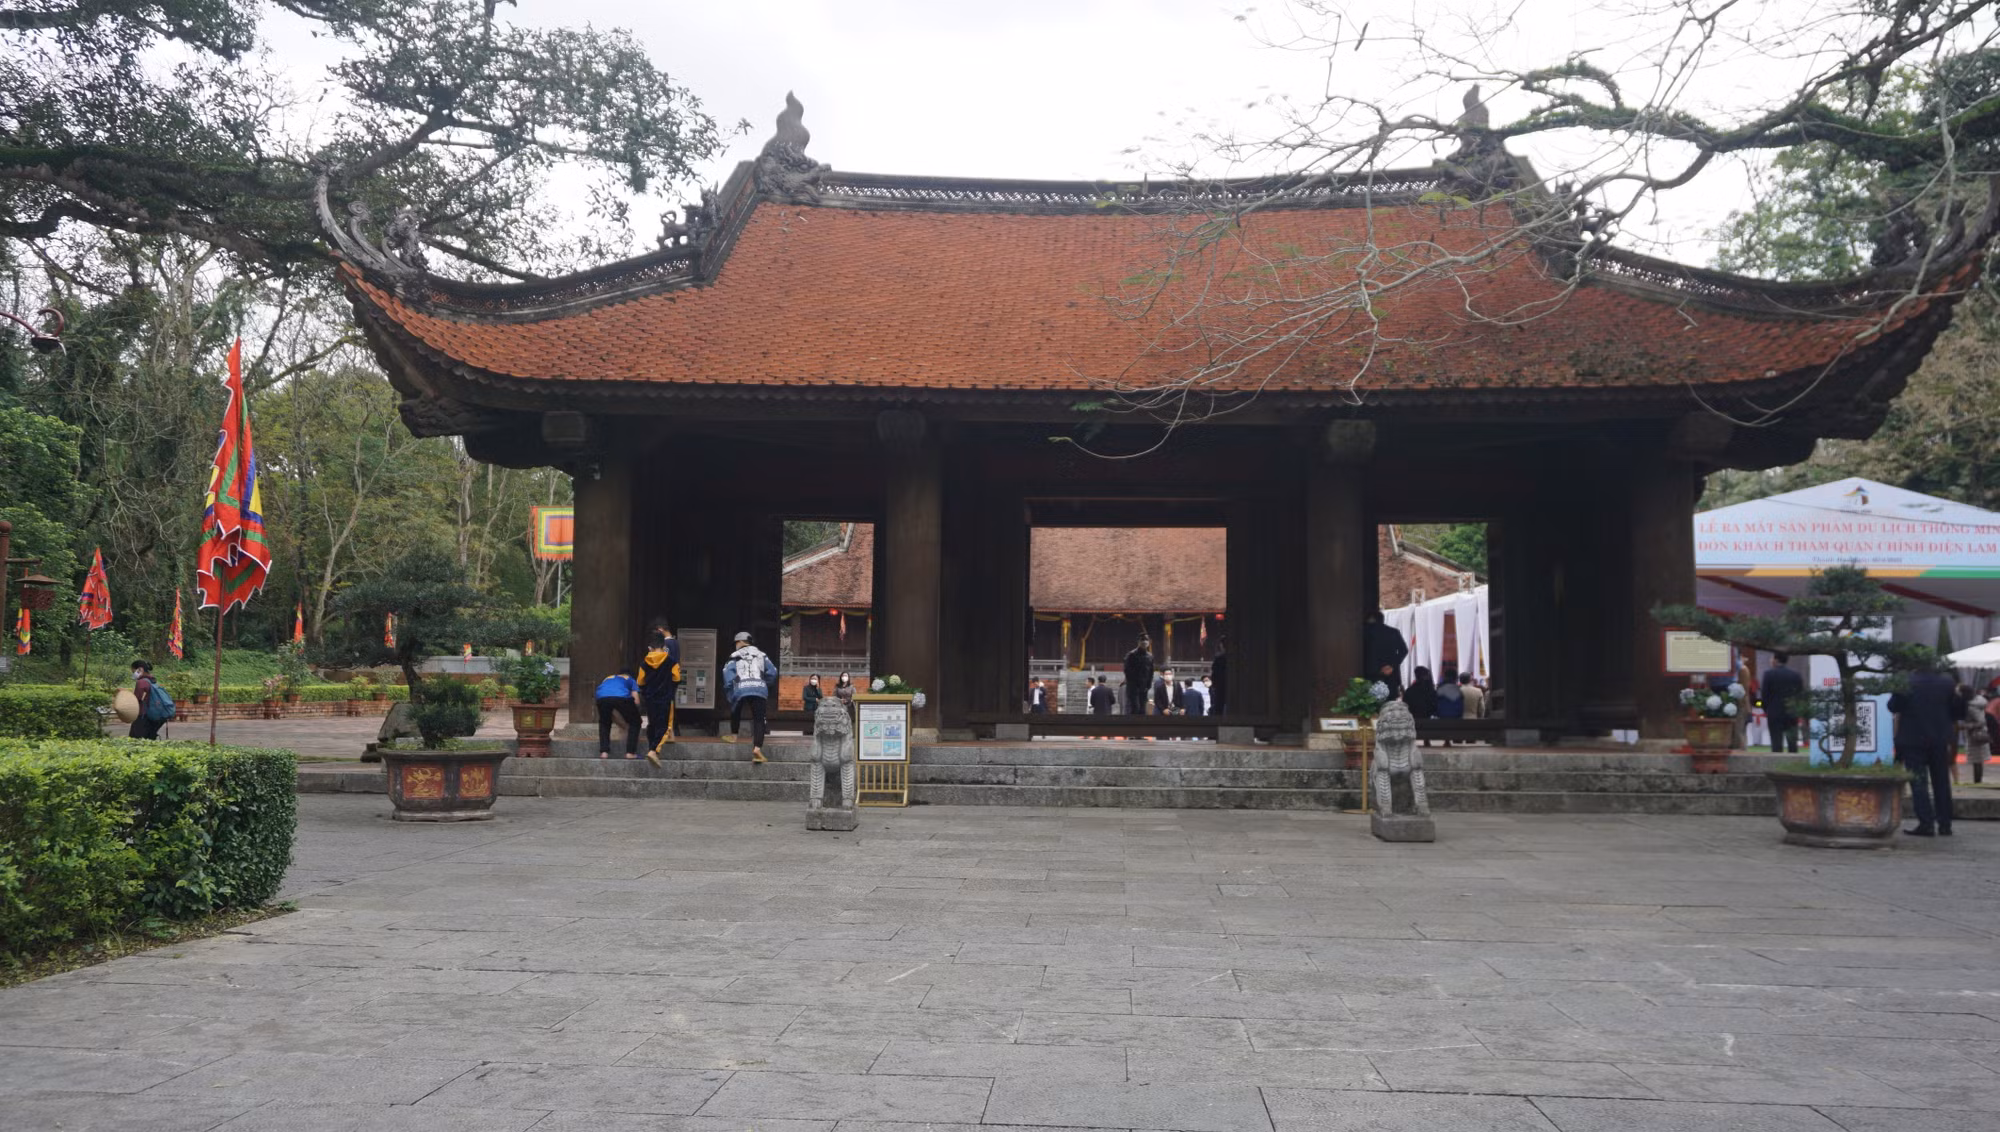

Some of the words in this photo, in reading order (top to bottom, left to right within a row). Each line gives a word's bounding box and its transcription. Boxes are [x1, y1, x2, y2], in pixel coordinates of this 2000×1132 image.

[1722, 522, 1741, 533] RA
[1857, 522, 1877, 533] DU
[1881, 522, 1916, 536] LỊCH
[1697, 538, 1729, 551] ĐÓN
[1733, 538, 1784, 551] KHÁCH
[1788, 540, 1829, 552] THAM
[1833, 540, 1873, 554] QUAN
[1928, 539, 1963, 555] ĐIỆN
[1967, 542, 1998, 553] LAM
